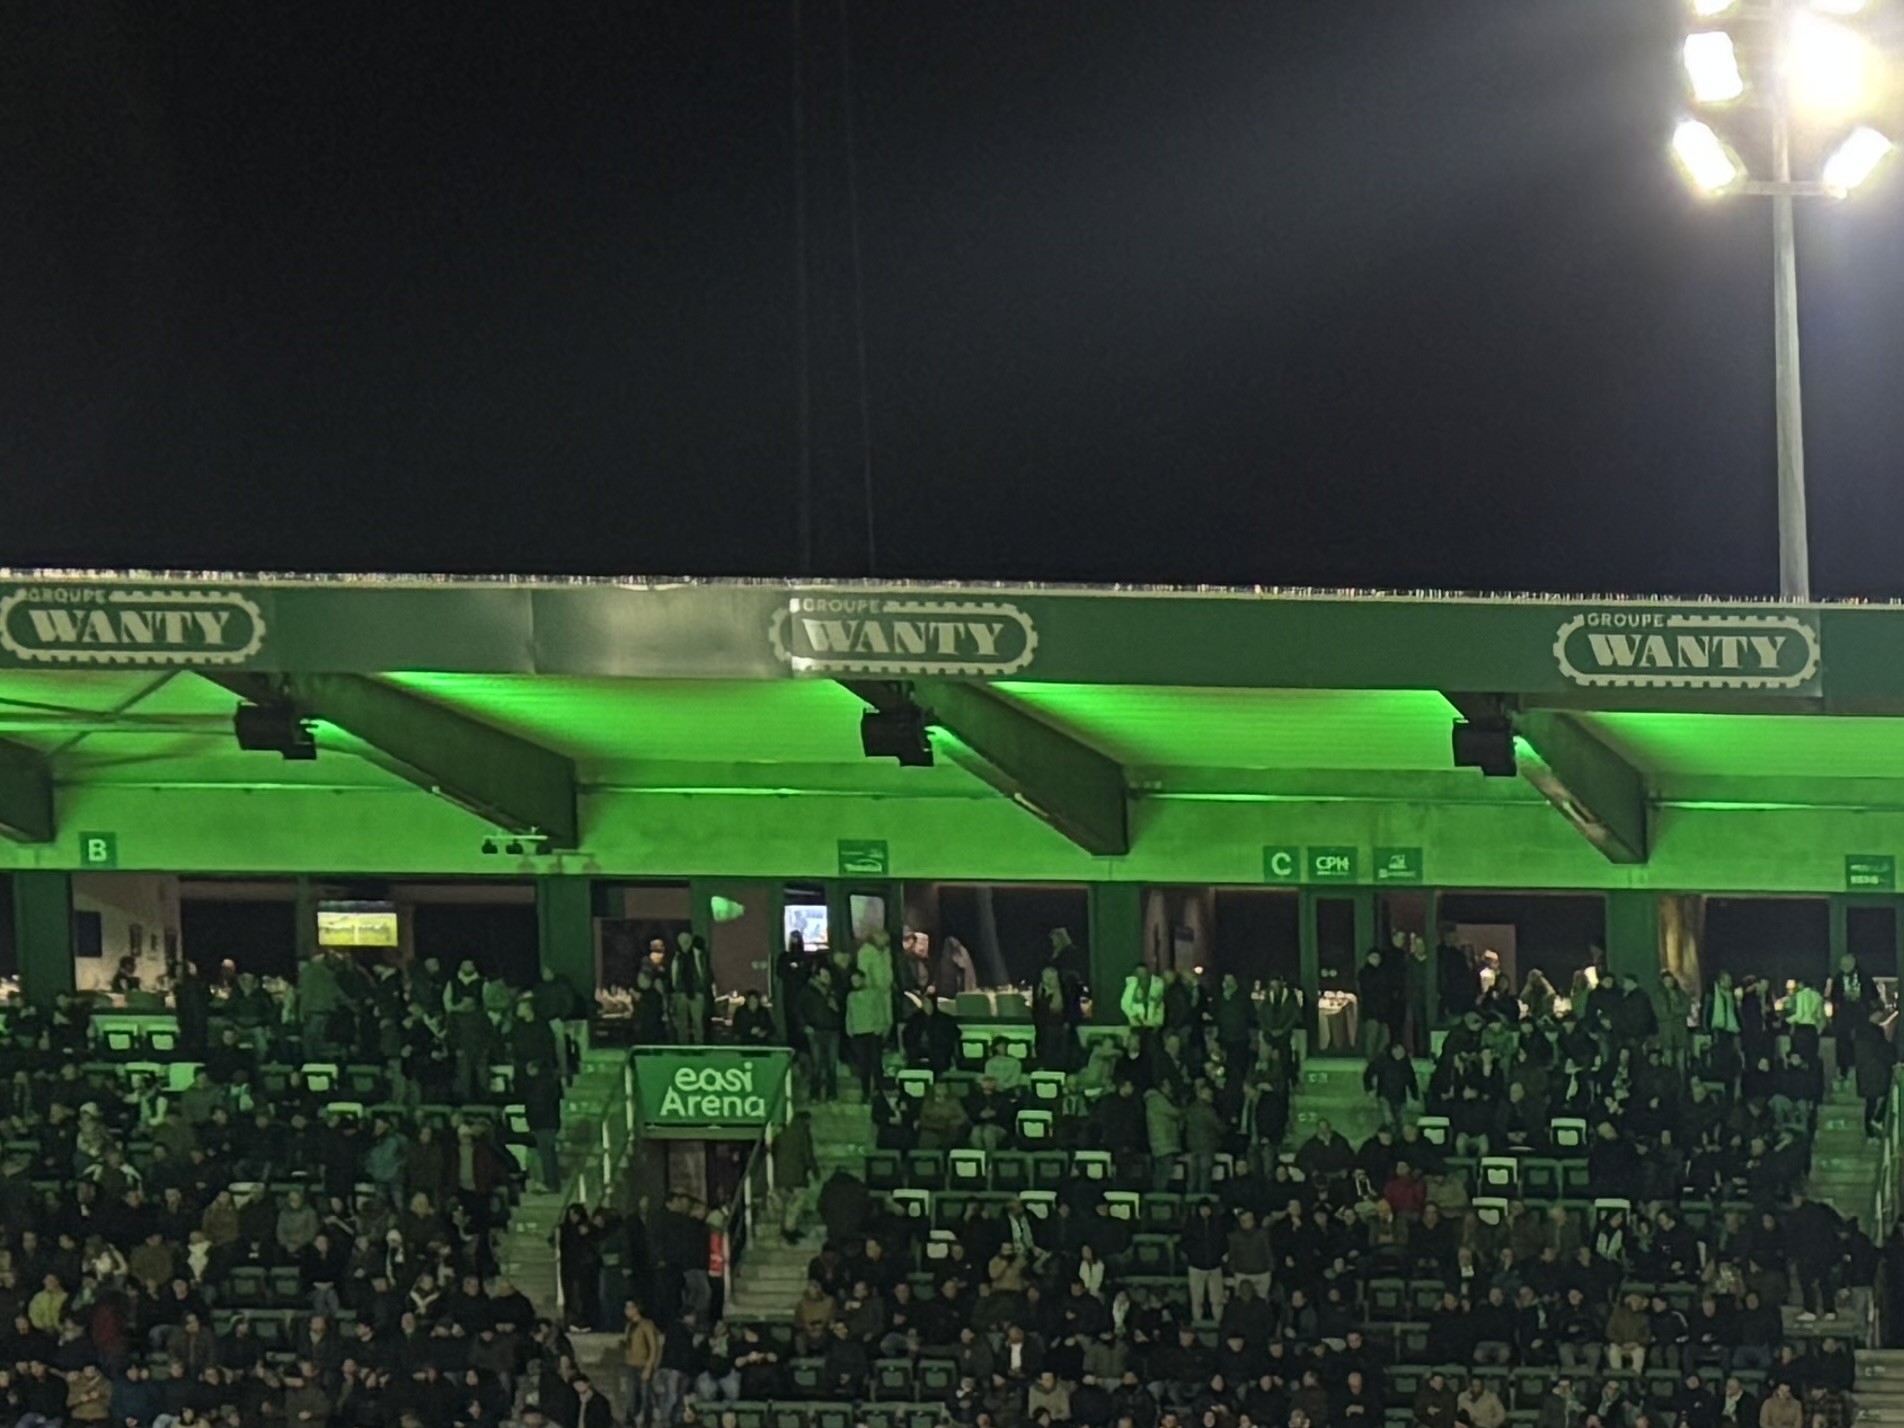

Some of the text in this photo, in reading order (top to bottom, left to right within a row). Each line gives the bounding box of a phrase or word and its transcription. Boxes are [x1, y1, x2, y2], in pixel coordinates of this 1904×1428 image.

[803, 598, 880, 613] GROUPE
[1587, 613, 1665, 627] GROUPE
[29, 610, 232, 646] WANTY
[802, 618, 1005, 655] WANTY
[1588, 634, 1787, 669] WANTY
[88, 839, 108, 862] B
[1271, 851, 1293, 876] C
[675, 1061, 753, 1092] easi
[659, 1085, 767, 1117] Arena
